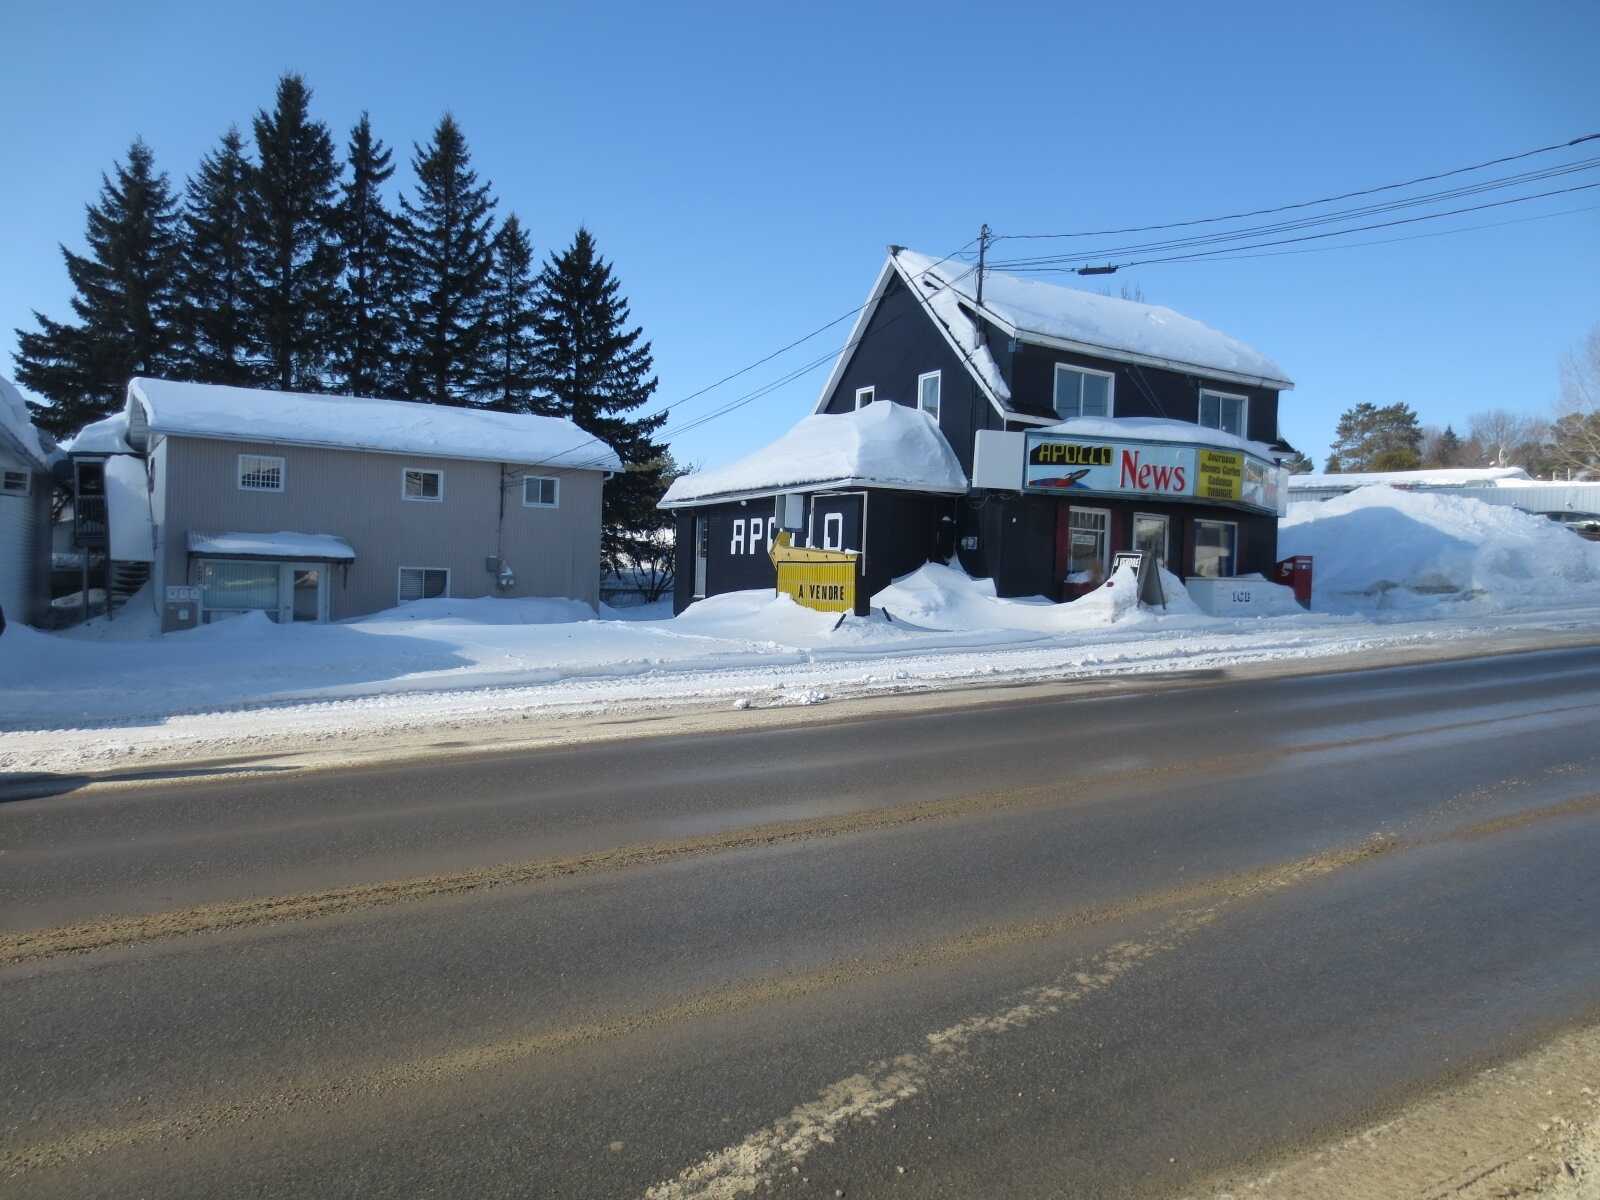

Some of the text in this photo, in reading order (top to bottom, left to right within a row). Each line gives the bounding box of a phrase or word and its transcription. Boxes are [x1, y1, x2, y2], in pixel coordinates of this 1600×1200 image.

[1039, 443, 1113, 466] APOLLO
[1120, 449, 1186, 492] News
[731, 513, 843, 555] APO
[798, 585, 844, 601] A VENDRE
